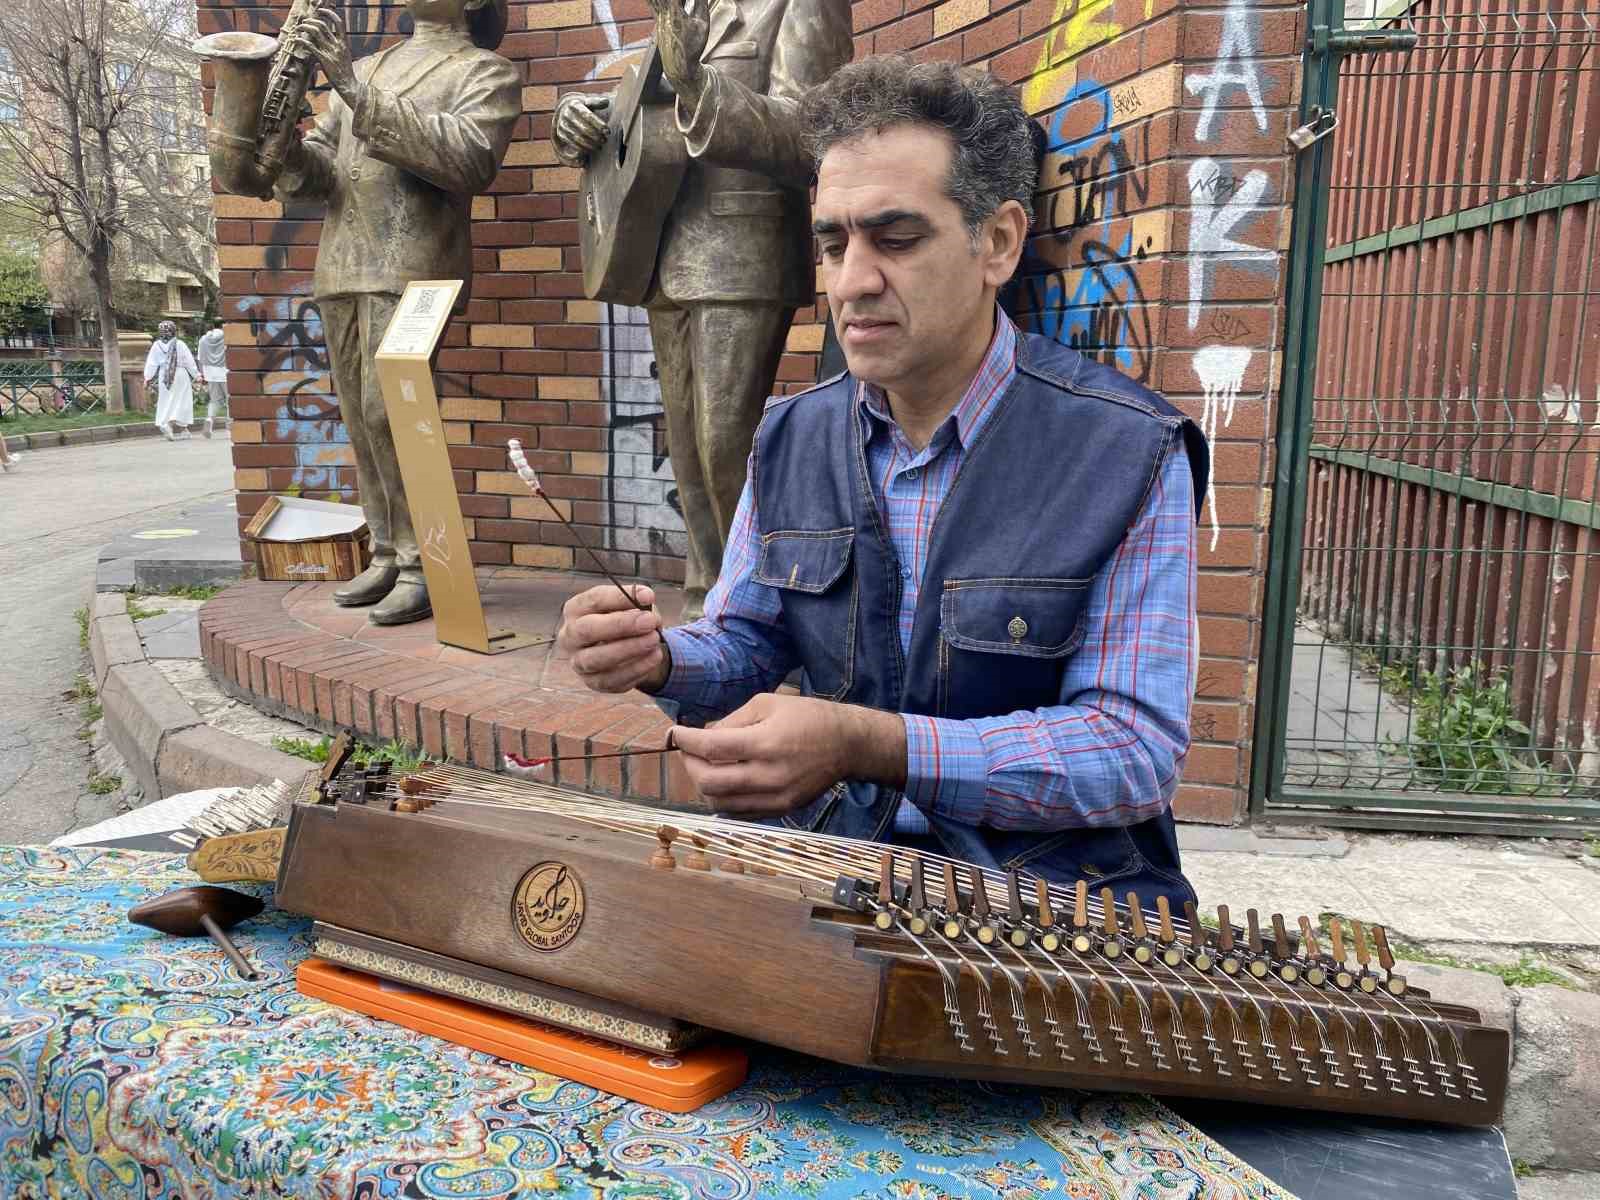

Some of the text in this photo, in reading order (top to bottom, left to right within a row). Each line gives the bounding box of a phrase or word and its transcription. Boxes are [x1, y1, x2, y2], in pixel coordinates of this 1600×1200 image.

[517, 901, 581, 946] JAVID GLOBAL SANTOOR
